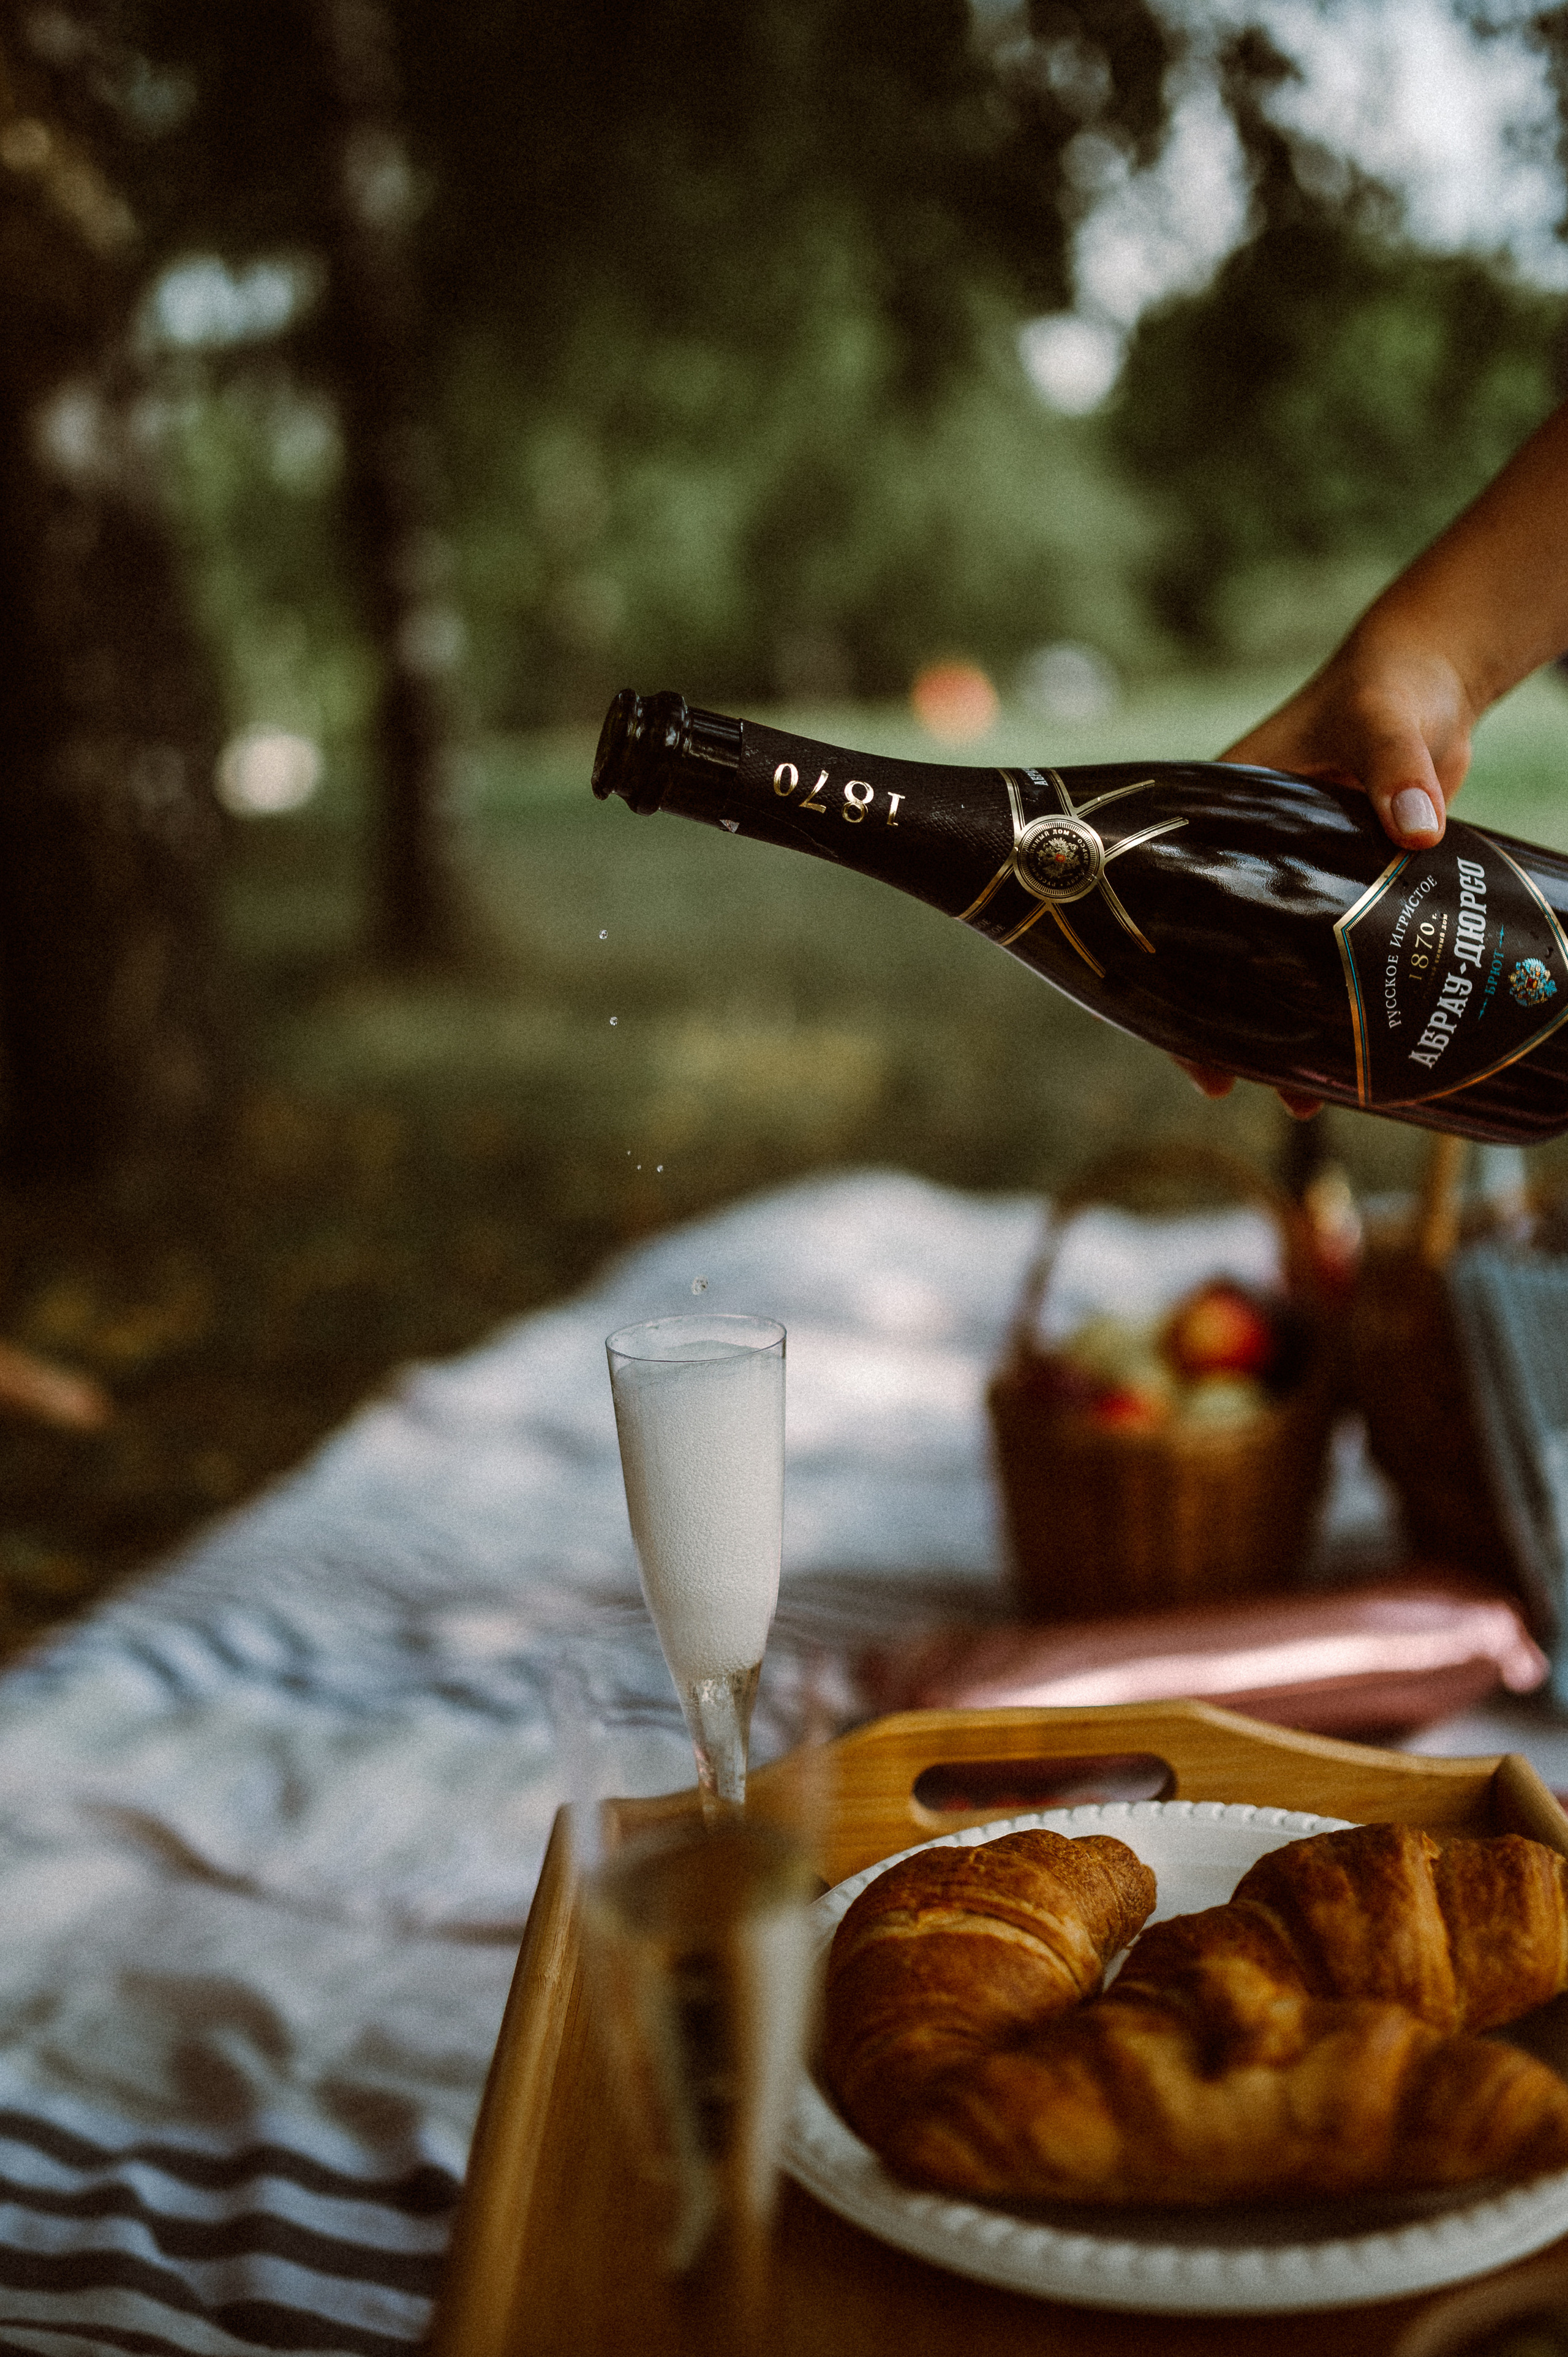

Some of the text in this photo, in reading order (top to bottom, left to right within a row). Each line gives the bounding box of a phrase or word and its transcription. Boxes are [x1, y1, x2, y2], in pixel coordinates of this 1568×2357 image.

[773, 762, 906, 827] 1870
[1389, 874, 1438, 949] ИГРИСТОЕ
[1408, 921, 1436, 982] 1870
[1484, 948, 1505, 996] БРЮТ
[1385, 954, 1402, 1029] РУССКОЕ
